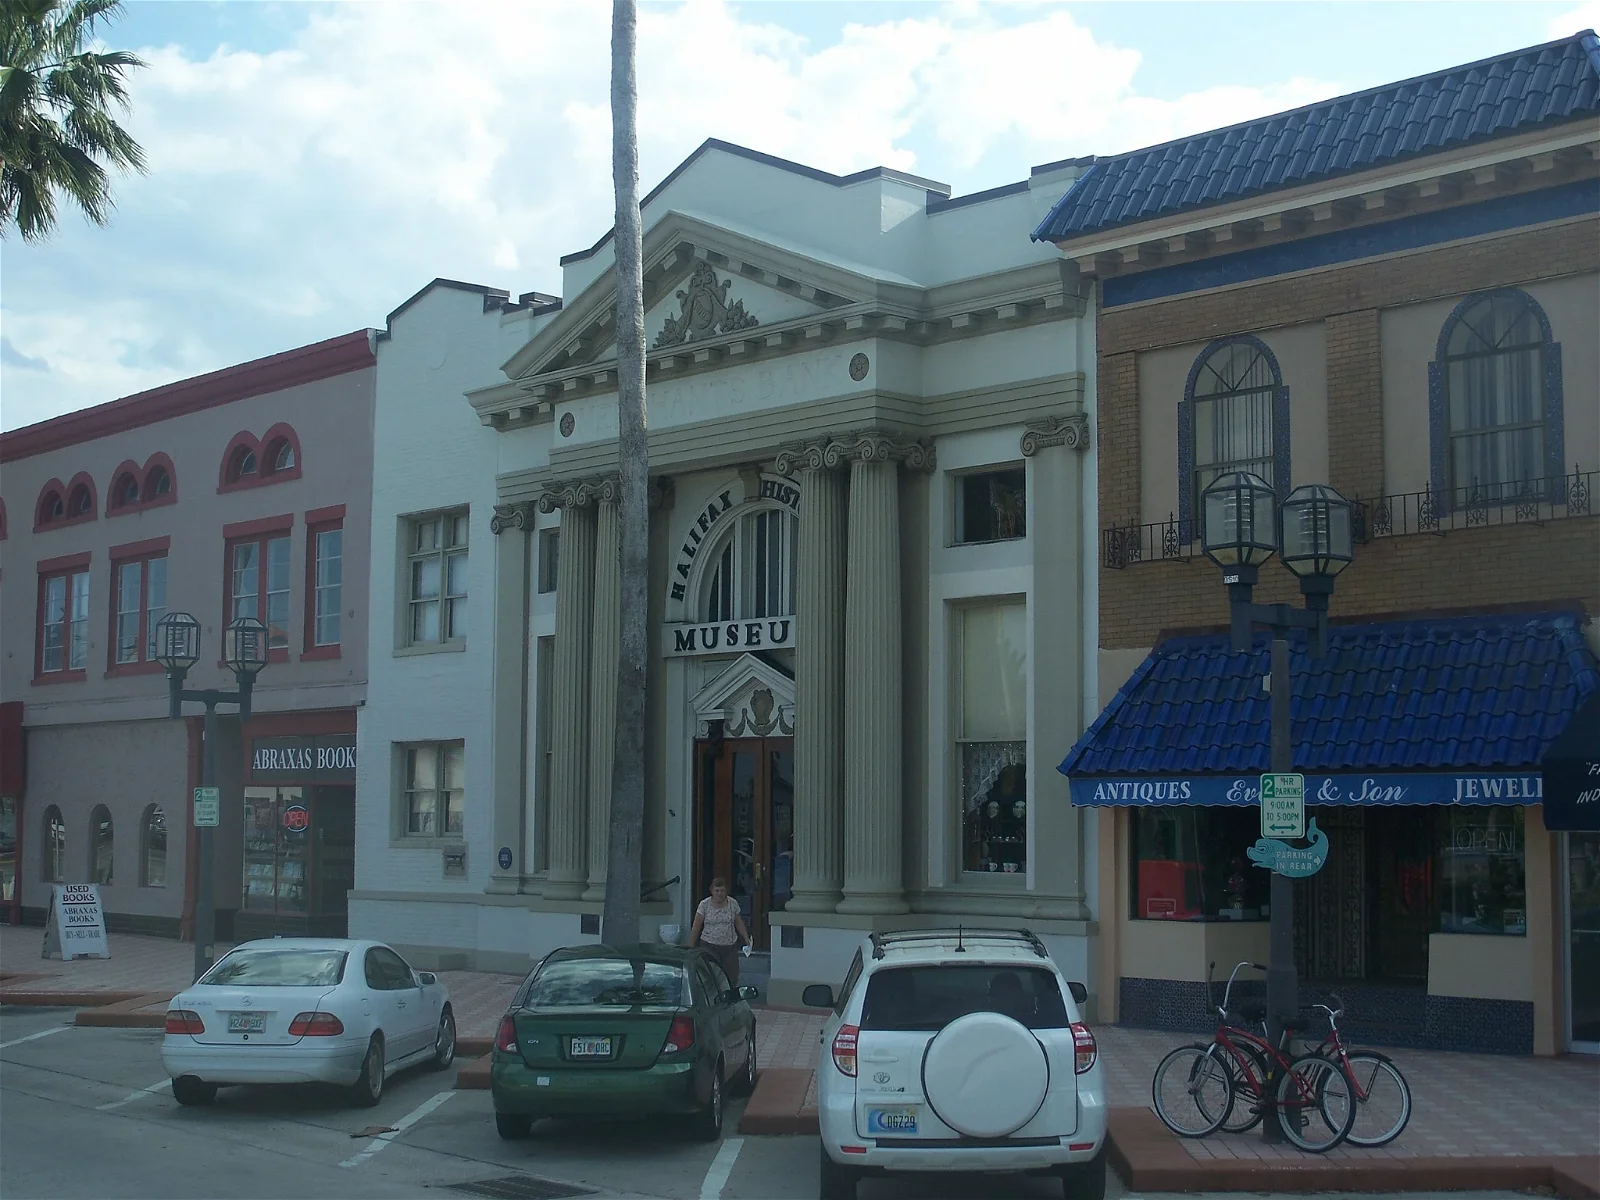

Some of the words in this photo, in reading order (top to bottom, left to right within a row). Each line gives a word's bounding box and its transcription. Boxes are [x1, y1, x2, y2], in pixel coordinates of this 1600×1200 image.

[758, 353, 842, 403] BANK
[671, 489, 733, 601] HALIFAX
[761, 480, 800, 515] HIST
[674, 620, 791, 651] MUSEU
[252, 747, 312, 770] ABRAXAS
[317, 746, 356, 769] BOOK
[1094, 781, 1191, 803] ANTIQUES
[1317, 778, 1341, 801] &
[1349, 778, 1408, 801] Son
[1263, 779, 1273, 795] 2
[1283, 777, 1294, 785] HR
[1275, 787, 1301, 796] PARKING
[195, 790, 202, 800] 2
[284, 811, 309, 828] OPEN
[1267, 812, 1274, 821] TO
[1456, 828, 1513, 851] OPEN
[1276, 851, 1313, 860] PARKING
[1276, 862, 1285, 870] IN
[1289, 862, 1312, 870] REAR
[66, 885, 89, 893] USED
[63, 893, 95, 901] BOOKS
[68, 915, 95, 923] BOOKS
